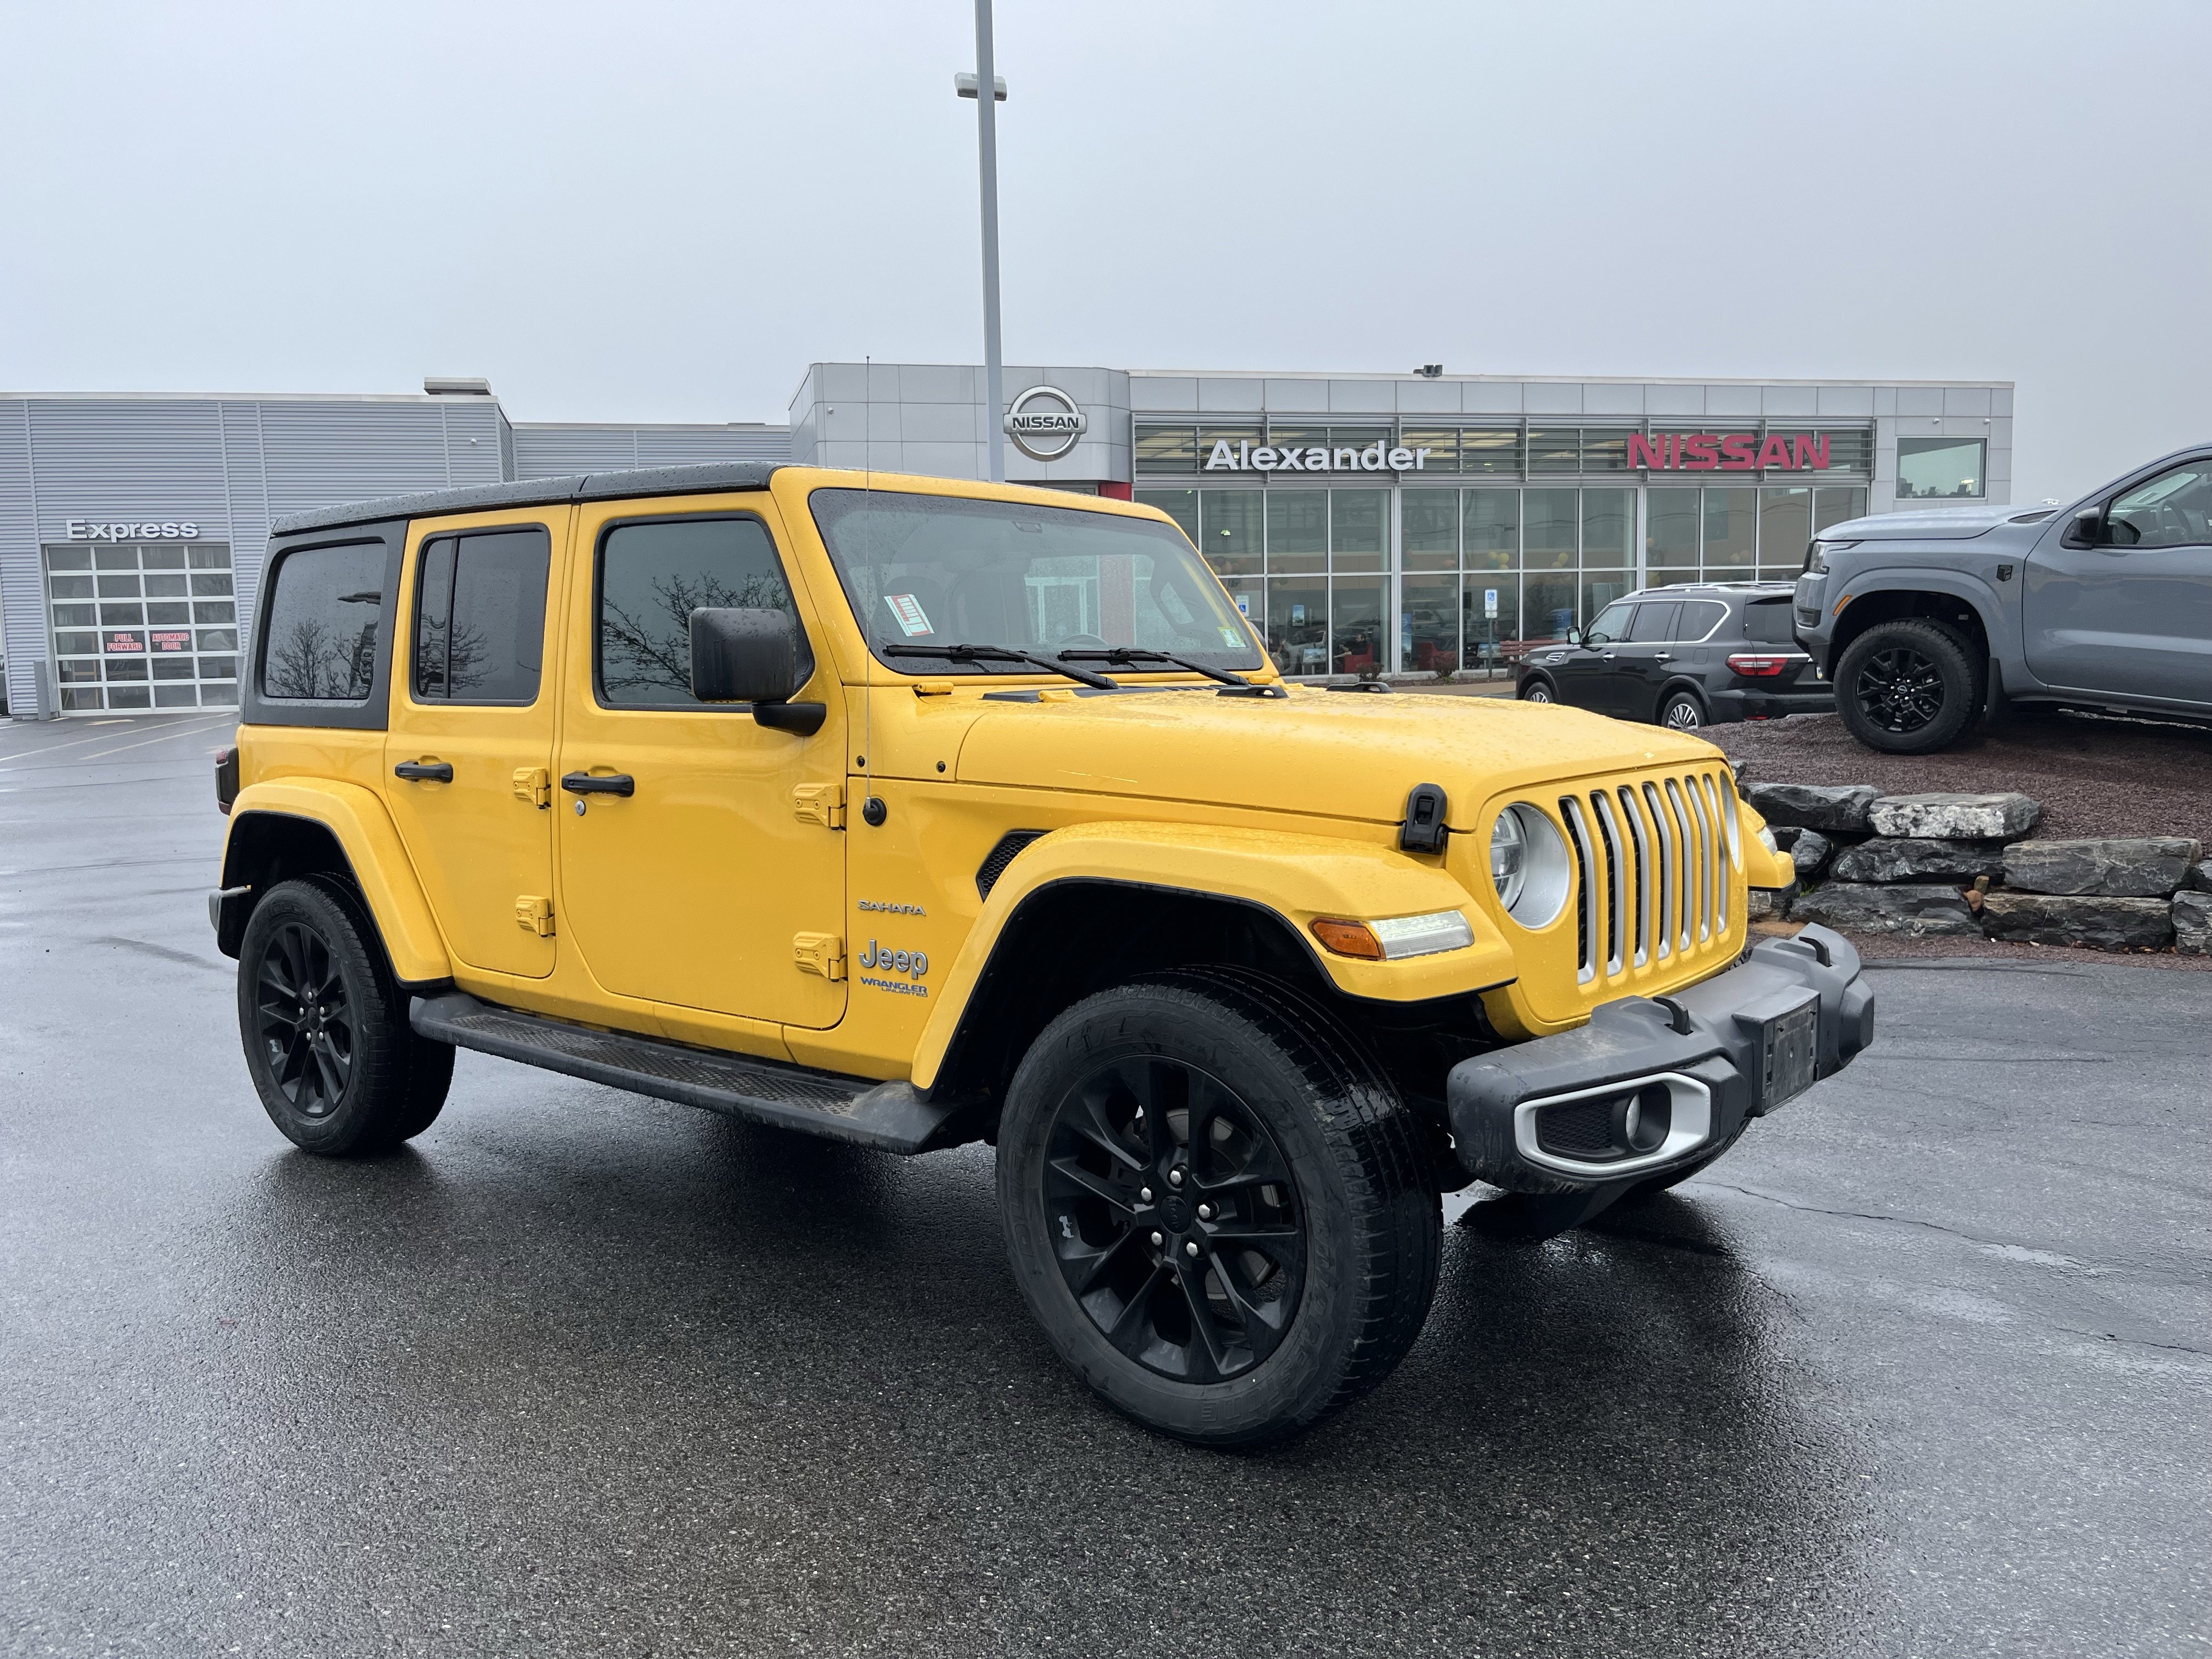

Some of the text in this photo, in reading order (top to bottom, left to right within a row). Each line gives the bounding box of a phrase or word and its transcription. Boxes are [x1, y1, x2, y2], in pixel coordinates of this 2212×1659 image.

[1012, 417, 1080, 430] NISSAN
[1205, 440, 1431, 471] Alexander
[1627, 433, 1830, 470] NISSAN
[65, 519, 199, 543] Express
[115, 634, 134, 642] PULL
[152, 633, 189, 642] AUTOMATIC
[162, 642, 182, 650] DOOR
[107, 642, 143, 651] FORWARD
[858, 899, 927, 916] SAHARA
[859, 939, 928, 980] Jeep
[860, 977, 927, 994] WRANGLER
[882, 987, 928, 997] UNLIMITED
[1009, 1064, 1053, 1256] DUELER
